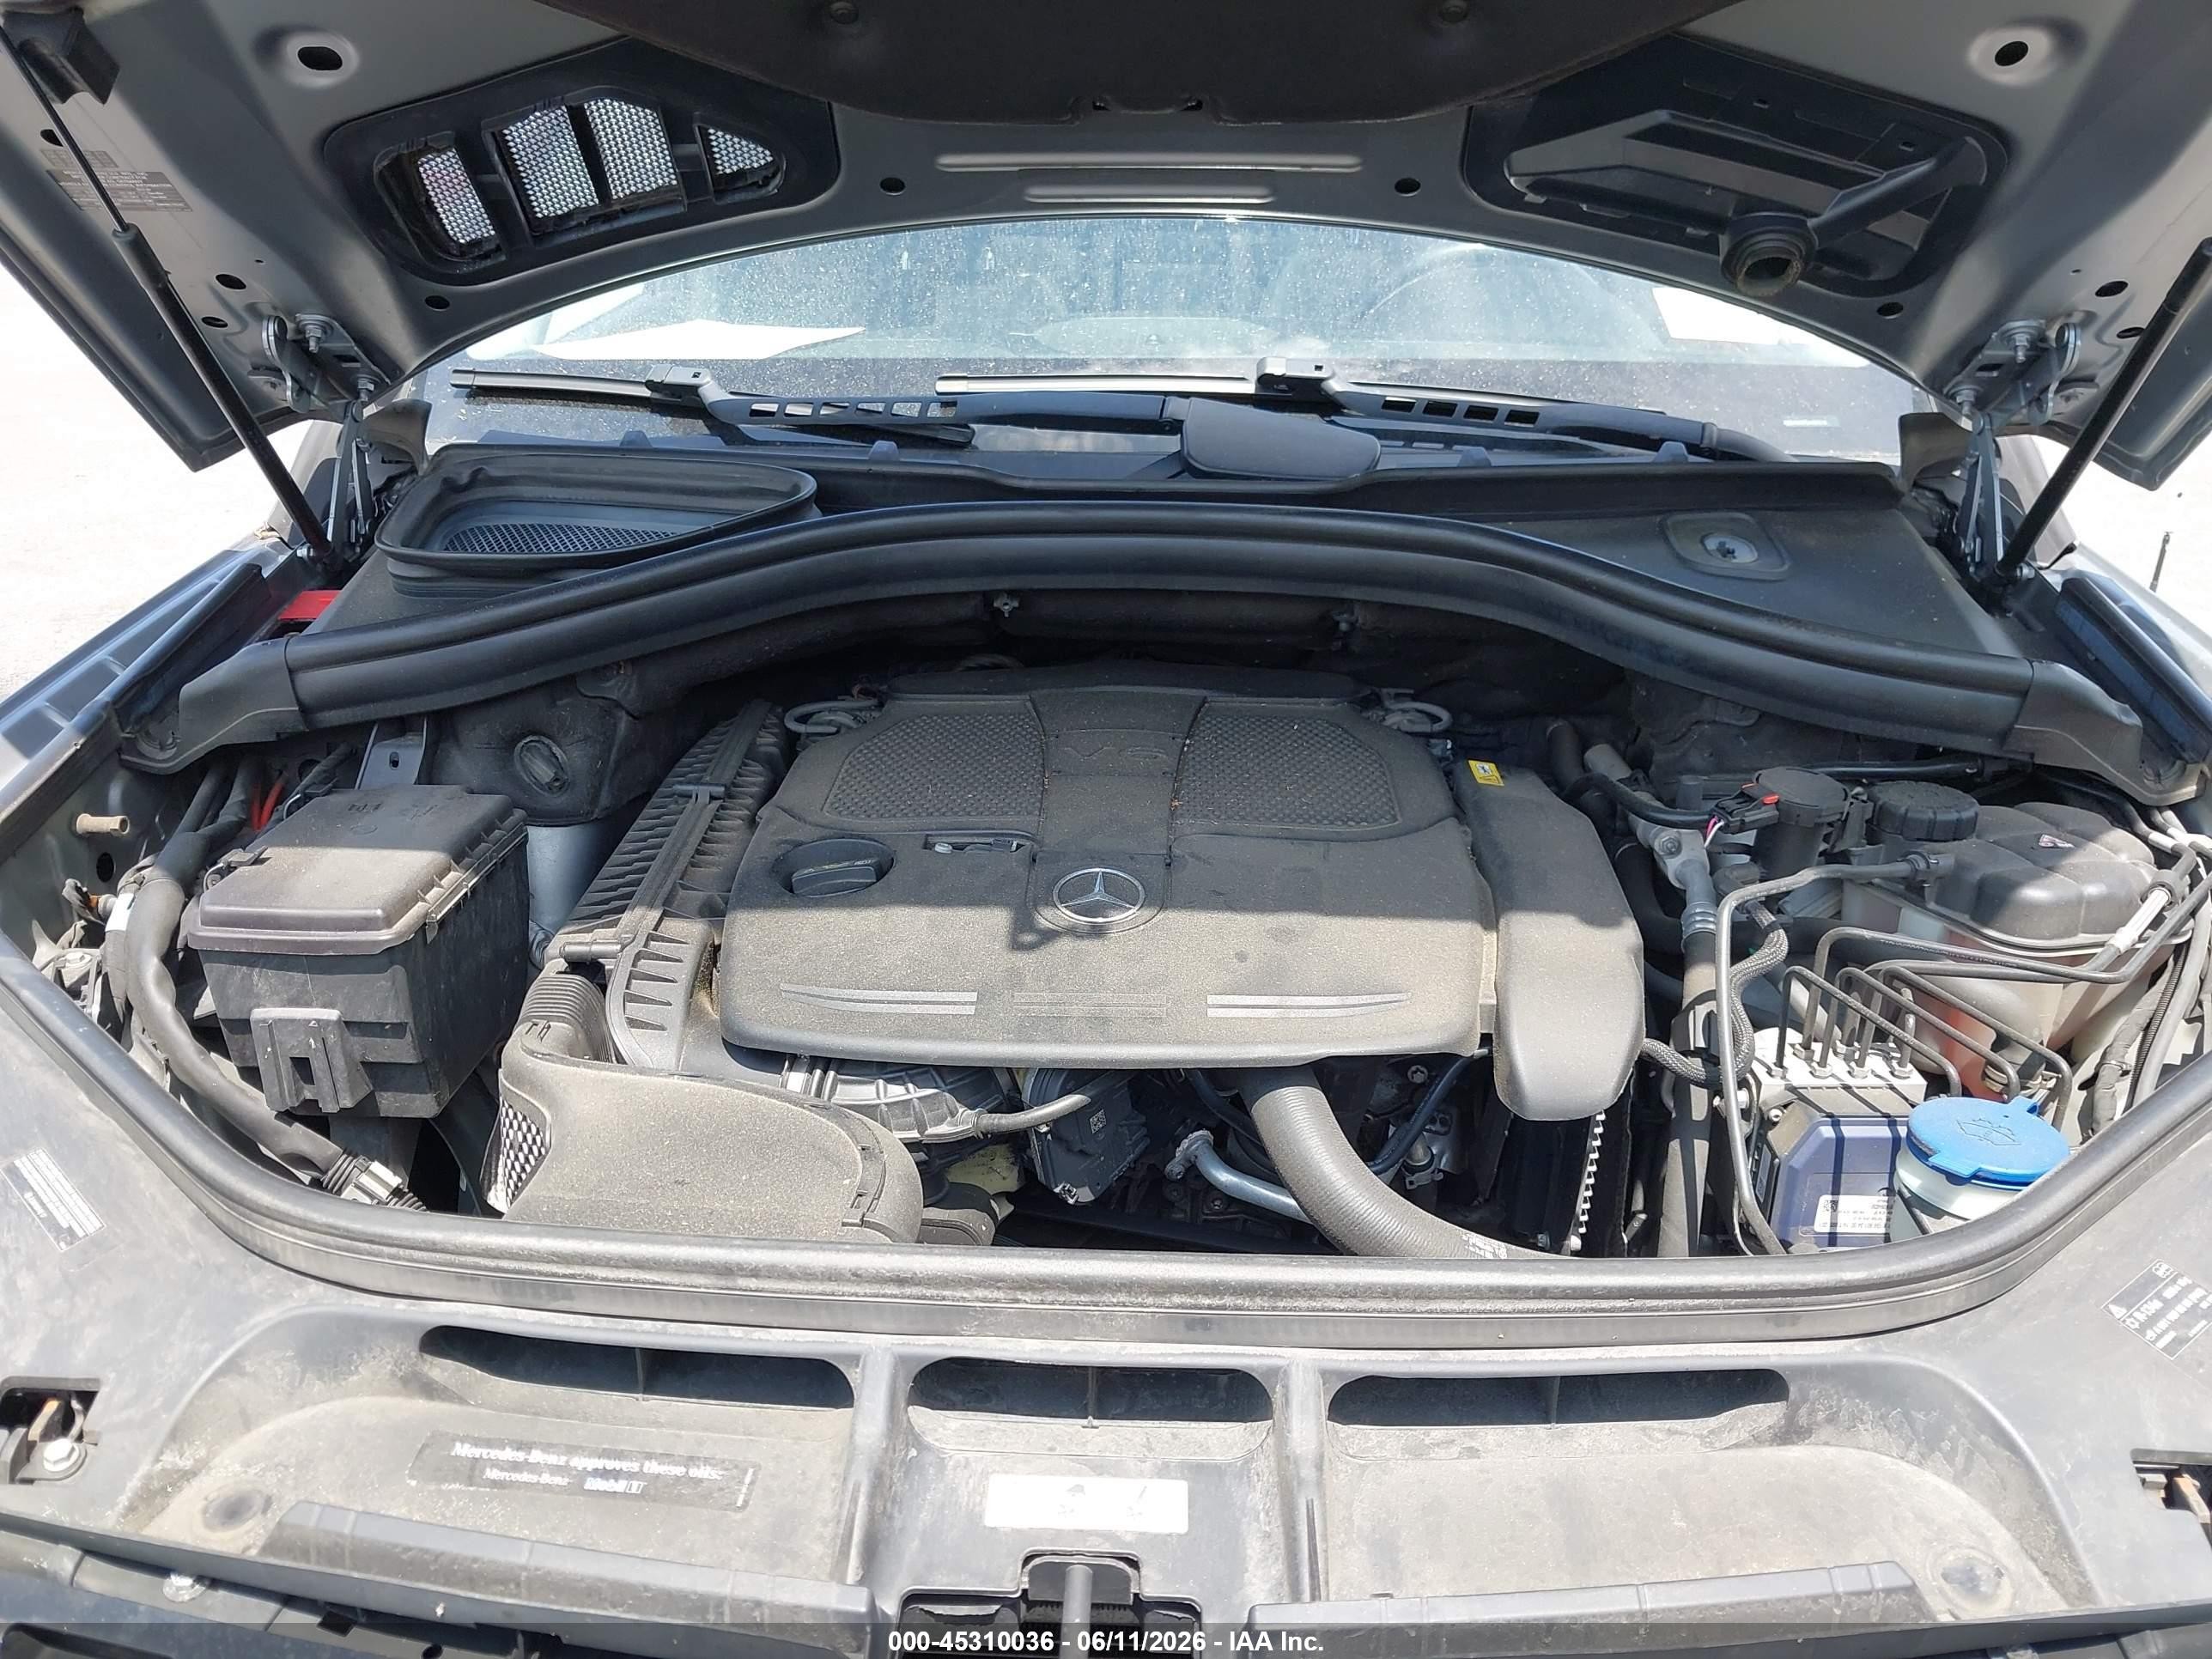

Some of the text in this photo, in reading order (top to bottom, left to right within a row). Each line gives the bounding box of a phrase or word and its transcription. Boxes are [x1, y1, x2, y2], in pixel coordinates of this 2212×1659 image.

[451, 1442, 568, 1467] Mercedes-Benz
[569, 1456, 640, 1473] approves
[642, 1460, 687, 1477] these
[483, 1468, 570, 1486] Mercedes-Benz
